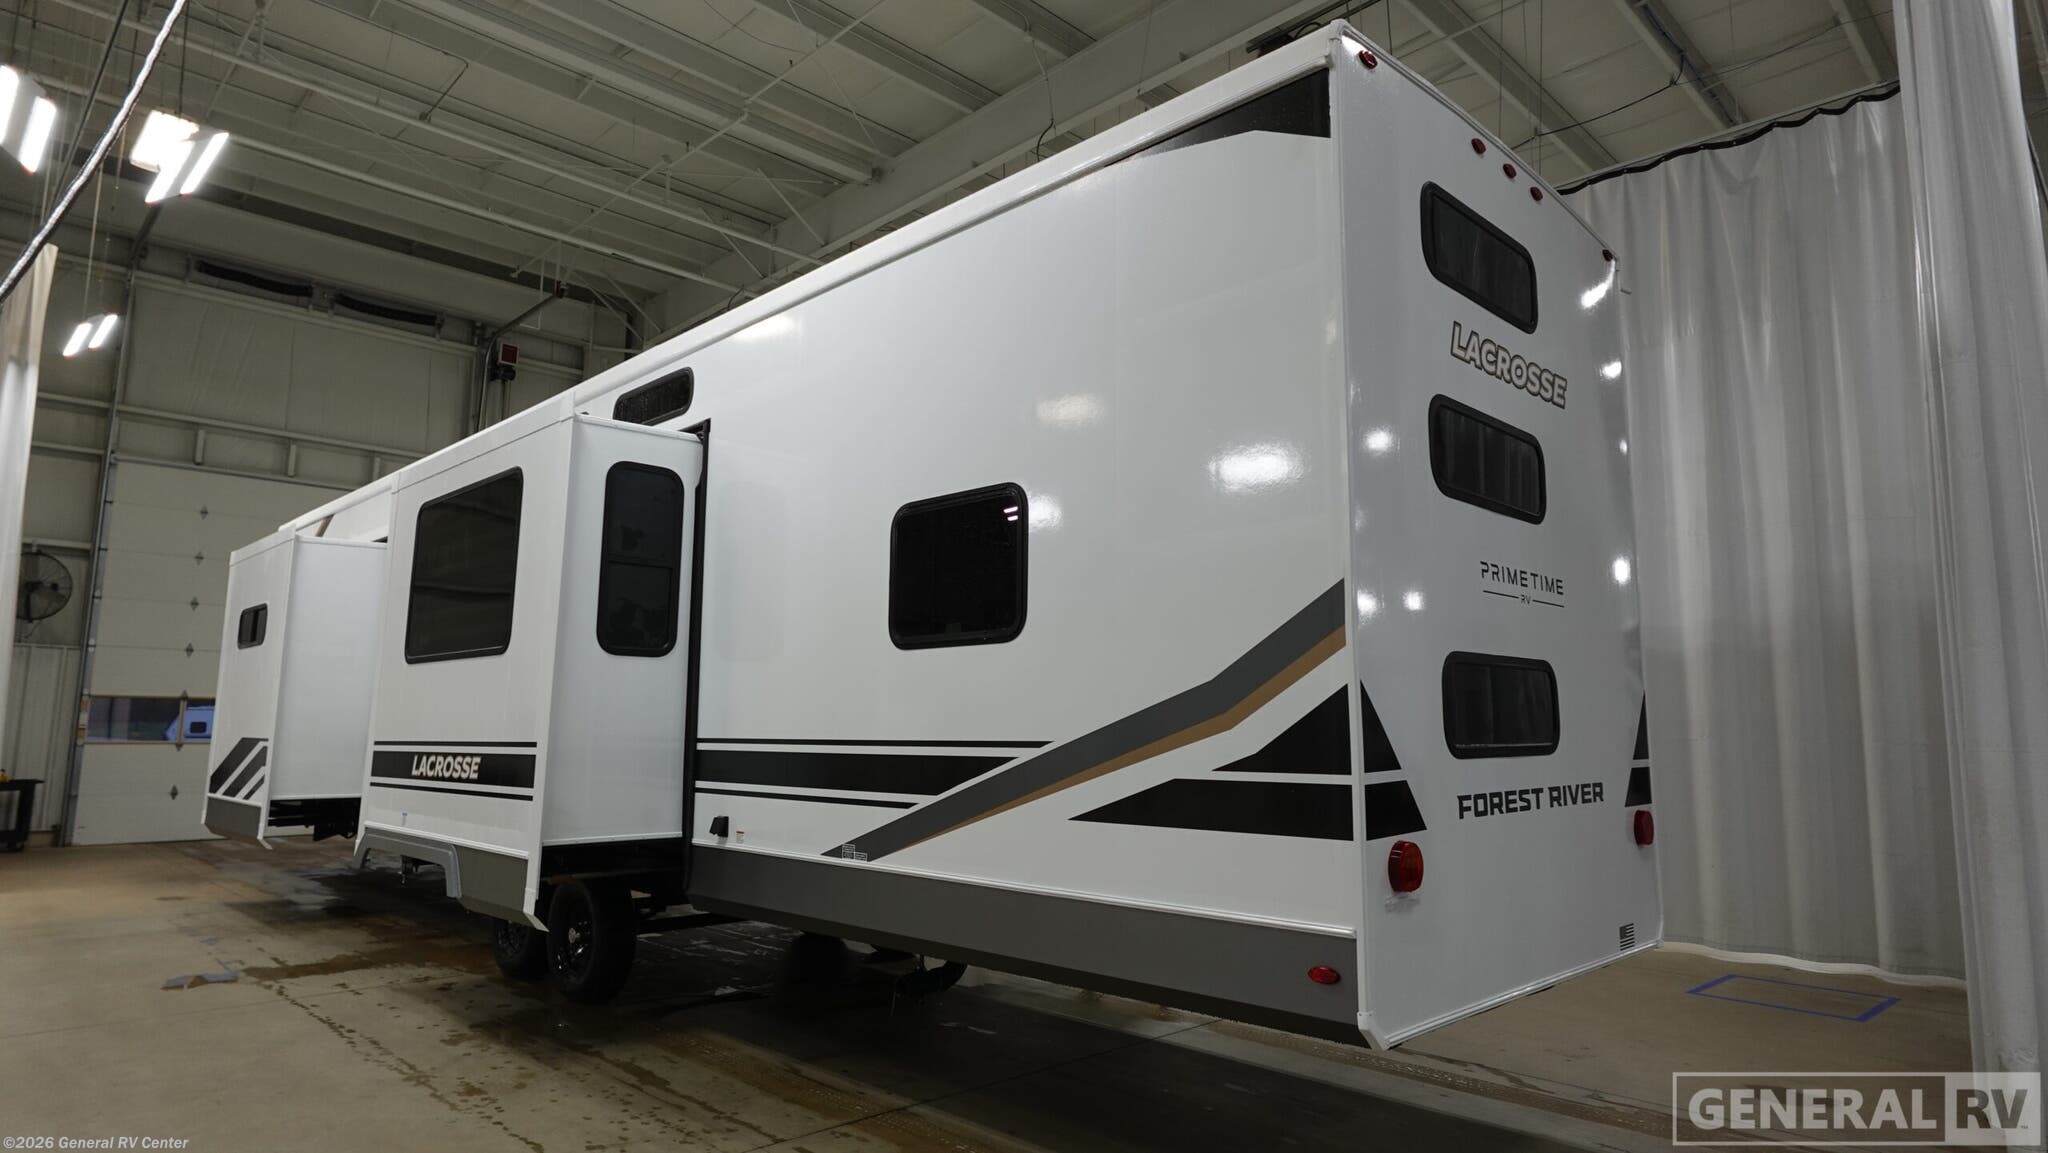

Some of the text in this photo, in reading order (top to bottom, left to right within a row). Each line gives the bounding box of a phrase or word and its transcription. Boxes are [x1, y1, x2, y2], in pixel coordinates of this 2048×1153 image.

[1450, 320, 1567, 410] LACROSSE
[1480, 561, 1564, 595] PRIMETIME
[1520, 594, 1531, 604] RV
[411, 754, 481, 779] LACROSSE
[1457, 782, 1604, 820] FOREST RIVER
